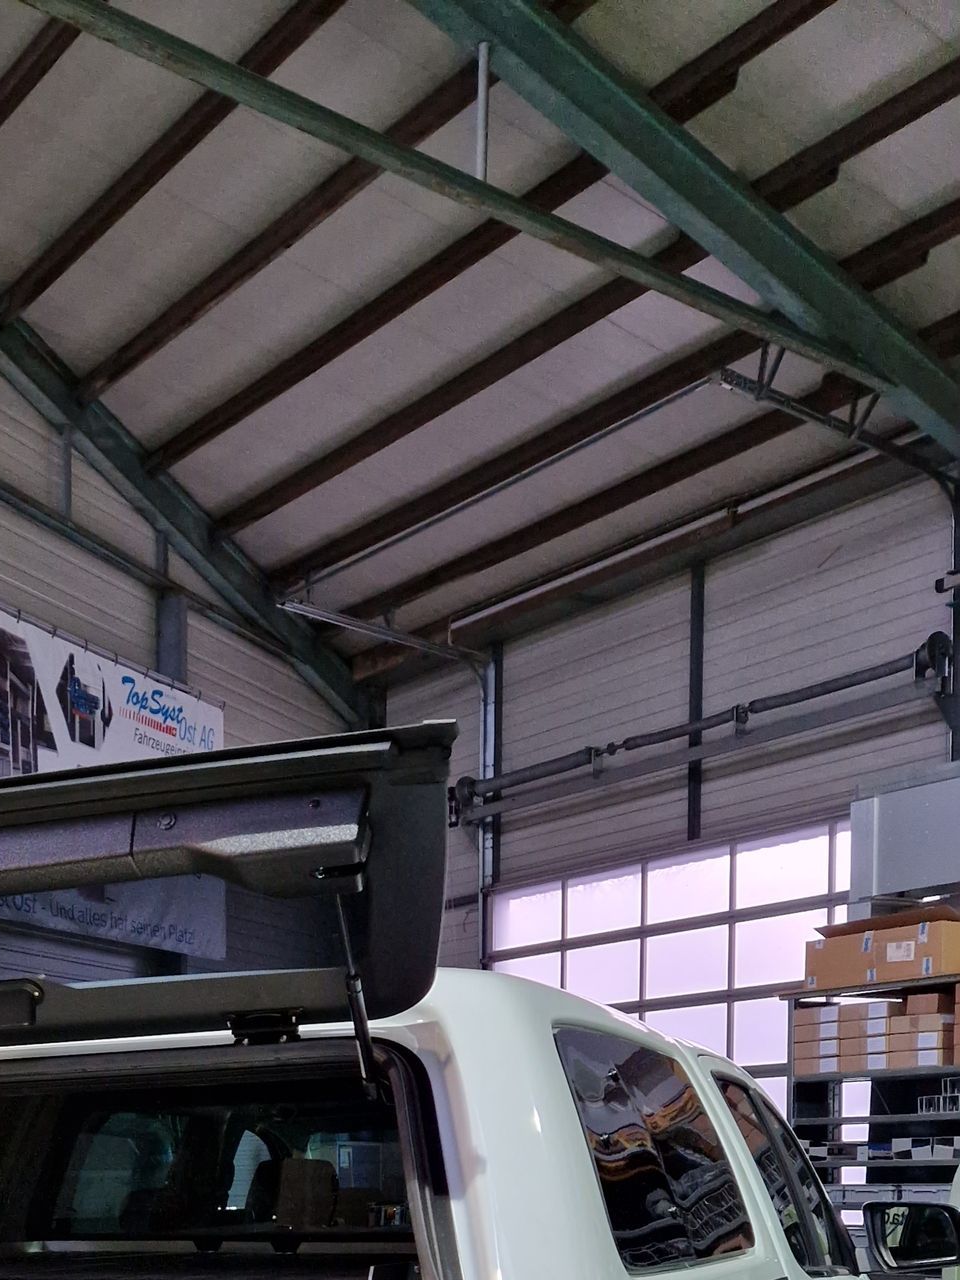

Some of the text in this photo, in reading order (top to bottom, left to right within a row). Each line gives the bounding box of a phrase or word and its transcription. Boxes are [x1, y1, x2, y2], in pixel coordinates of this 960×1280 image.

[121, 676, 215, 751] TopSyst Ost AG
